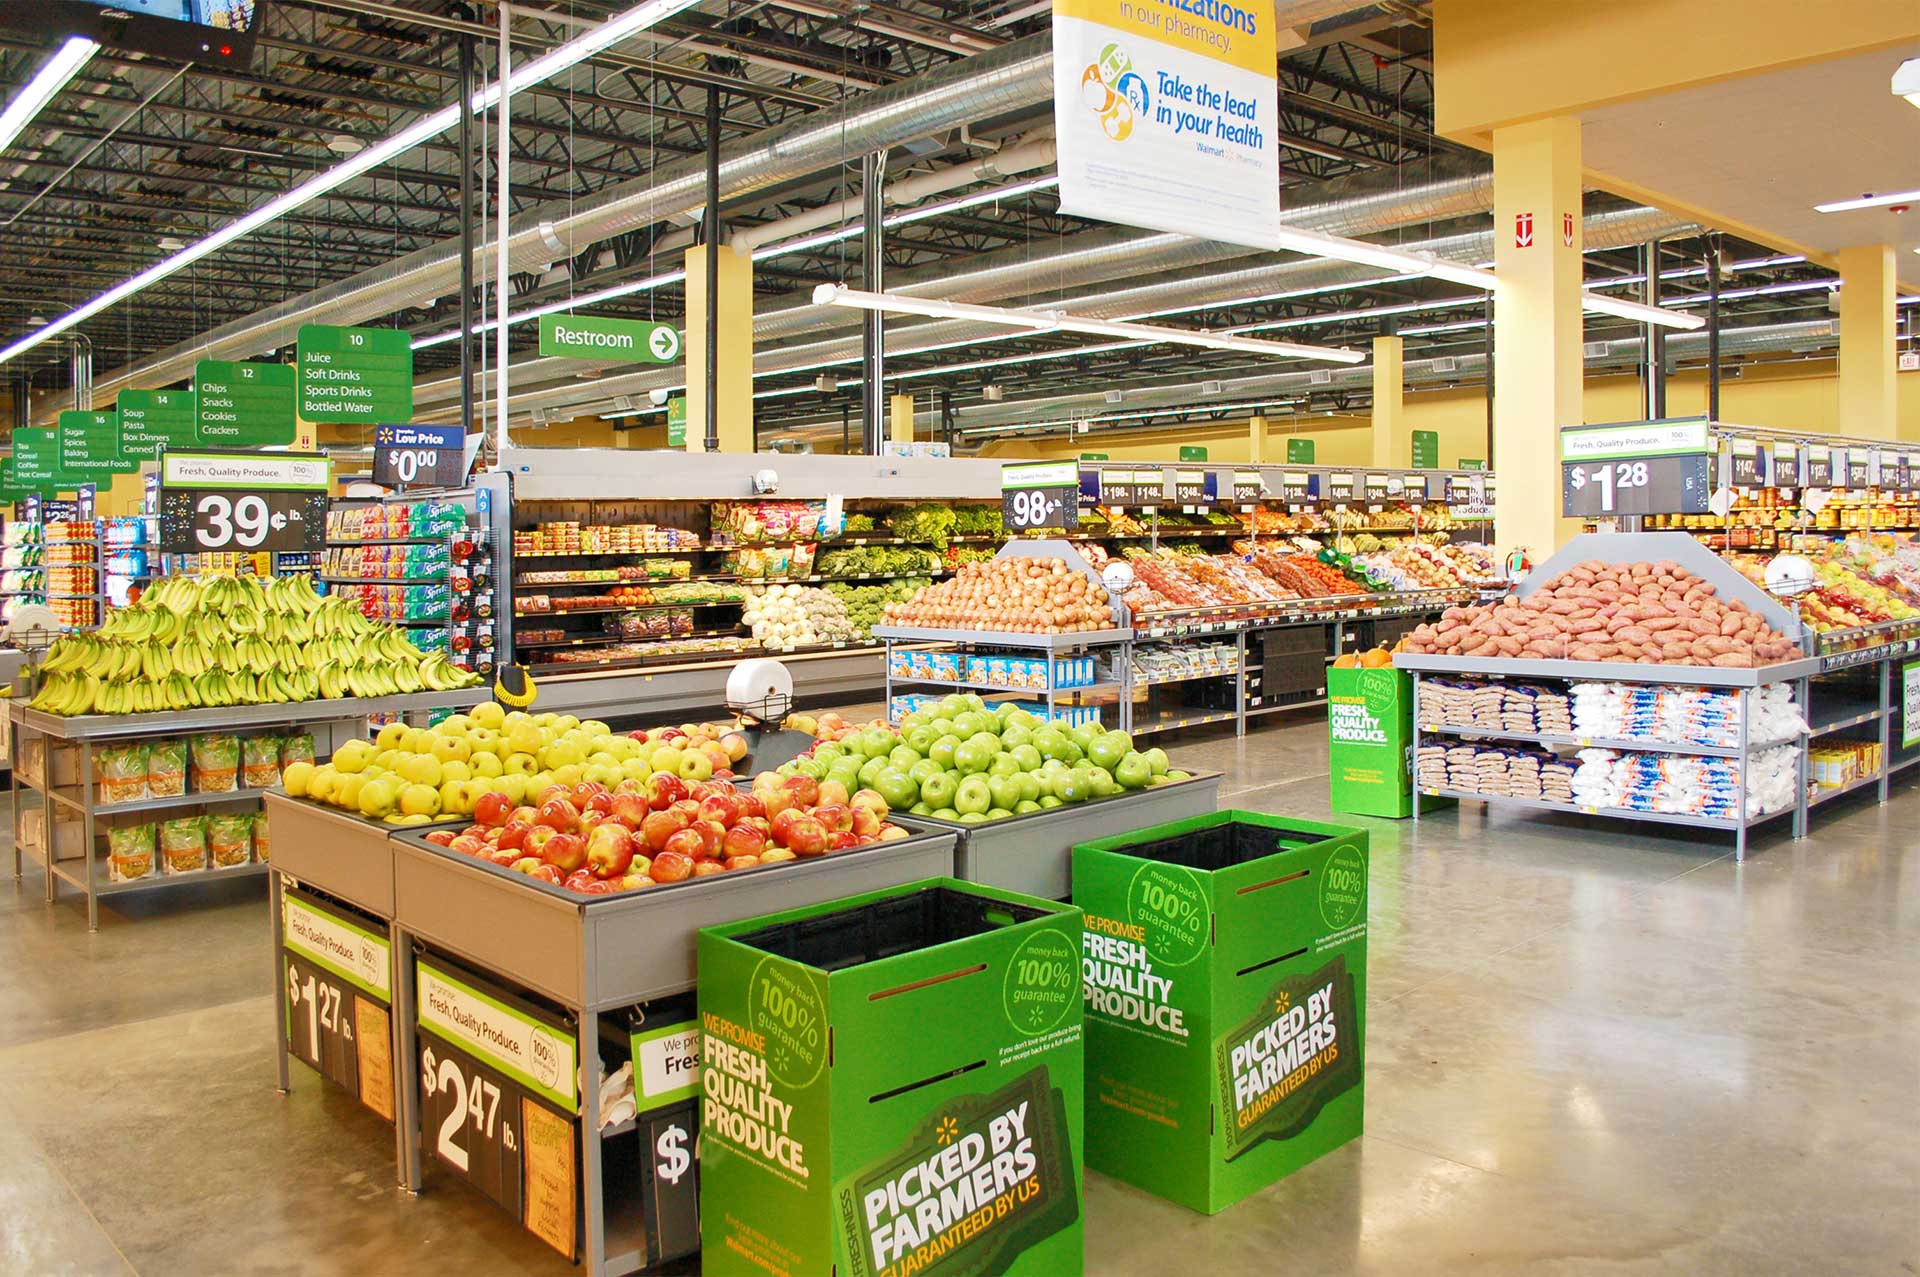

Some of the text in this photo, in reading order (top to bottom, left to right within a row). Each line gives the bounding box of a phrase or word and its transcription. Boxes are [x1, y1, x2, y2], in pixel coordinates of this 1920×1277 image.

[1120, 2, 1232, 54] in our pharmacy.
[1157, 70, 1257, 120] Take the lead
[1156, 99, 1263, 150] in your health
[1195, 142, 1225, 158] Walmart
[349, 335, 364, 346] 10
[555, 326, 634, 349] Restroom
[305, 352, 331, 363] Juice
[242, 368, 253, 378] 12
[305, 368, 361, 381] Soft Drinks
[202, 383, 227, 394] Chips
[305, 385, 372, 398] Sports Drinks
[158, 396, 168, 404] 14
[202, 398, 234, 408] Snacks
[305, 401, 373, 413] Bottled Water
[95, 416, 105, 424] 16
[123, 409, 145, 419] Soup
[202, 412, 237, 421] Cookies
[64, 428, 86, 437] Sugar
[123, 421, 145, 430] Pasta
[202, 425, 240, 436] Crackers
[64, 439, 87, 447] Spices
[123, 433, 170, 442] Box Dinners
[396, 434, 445, 445] Low Price
[1596, 439, 1624, 449] Quality
[1625, 436, 1660, 445] Produce.
[17, 452, 38, 460] Cereal
[64, 450, 89, 458] Baking
[123, 445, 154, 453] Canned
[64, 460, 132, 468] International Foods
[179, 466, 281, 478] Fresh, Quality Produce.
[479, 490, 488, 499] A
[479, 501, 487, 510] 9
[289, 509, 303, 521] lb.
[1362, 677, 1393, 696] 100%
[1331, 704, 1369, 718] FRESH,
[1331, 716, 1379, 730] QUALITY
[1332, 727, 1388, 742] PRODUCE.
[1150, 870, 1198, 901] money back
[1328, 868, 1361, 893] 100%
[1141, 880, 1200, 932] 100%
[1097, 916, 1146, 943] PROMISE
[1137, 907, 1196, 946] guarantee
[308, 927, 329, 951] Quality
[328, 937, 355, 961] Produce.
[1026, 945, 1069, 958] money back
[1083, 931, 1152, 976] FRESH,
[1017, 959, 1071, 989] 100%
[1083, 958, 1173, 1004] QUALITY
[769, 966, 816, 1009] money back
[1013, 989, 1066, 1004] guarantee
[760, 977, 818, 1048] 100%
[1083, 983, 1189, 1037] PRODUCE.
[342, 1016, 353, 1041] lb.
[429, 993, 522, 1056] Fresh, Quality Produce.
[1231, 1005, 1305, 1078] PICKED
[1307, 982, 1333, 1024] BY
[703, 1011, 766, 1055] WE PROMISE
[758, 1010, 814, 1065] guarantee
[663, 1038, 681, 1052] We
[703, 1034, 773, 1095] FRESH,
[1234, 1012, 1337, 1111] FARMERS
[1237, 1042, 1338, 1129] GUARANTEED BY US
[704, 1068, 793, 1134] QUALITY
[503, 1120, 517, 1152] lb.
[704, 1098, 810, 1178] PRODUCE.
[656, 1124, 690, 1184] $
[864, 1132, 985, 1231] PICKED
[988, 1100, 1029, 1156] BY
[995, 1187, 1017, 1219] BY
[1016, 1174, 1041, 1204] US
[871, 1138, 1037, 1271] FARMERS
